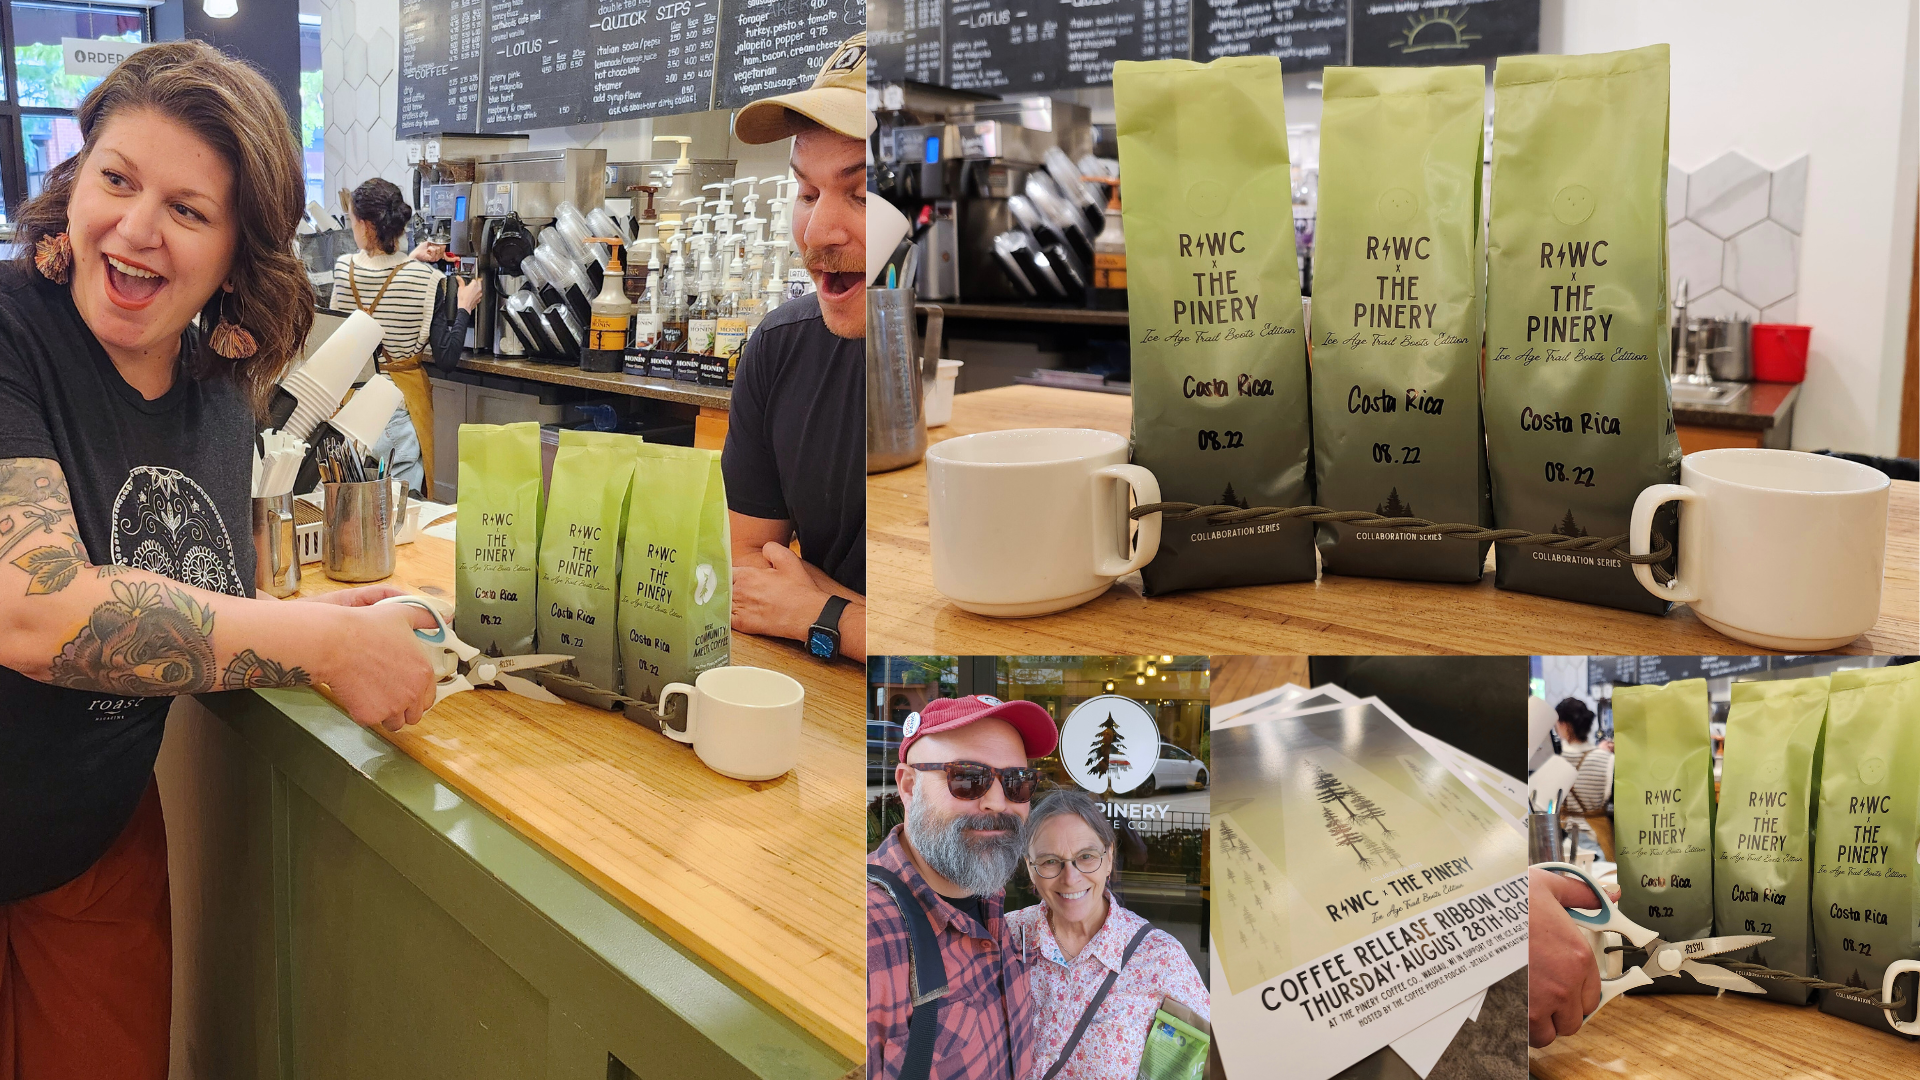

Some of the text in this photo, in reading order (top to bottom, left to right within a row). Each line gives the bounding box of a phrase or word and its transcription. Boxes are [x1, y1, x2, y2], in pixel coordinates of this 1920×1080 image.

[598, 4, 622, 16] double
[601, 1, 691, 31] QUICK SIPS
[738, 12, 770, 27] forager
[969, 9, 1011, 29] LOTUS
[773, 20, 796, 37] pesto
[807, 9, 837, 25] tomato
[506, 39, 543, 58] LOTUS
[597, 45, 620, 56] italian
[734, 38, 772, 55] jalapeño
[775, 31, 805, 49] popper
[790, 44, 816, 57] cream
[816, 39, 842, 53] cheese
[414, 64, 449, 80] COFFEE
[594, 66, 640, 80] hot chocolate
[734, 65, 777, 84] vegetarian
[594, 81, 622, 93] steamer
[740, 82, 762, 96] vegan
[593, 90, 642, 105] add syrup flavor
[608, 107, 621, 115] ask
[1192, 270, 1239, 297] THE
[1376, 276, 1419, 301] THE
[1550, 284, 1596, 312] THE
[1173, 294, 1259, 325] PINERY
[1353, 302, 1437, 329] PINERY
[1140, 322, 1297, 347] Ice Age Trail Boots Edition
[1526, 313, 1613, 343] PINERY
[1321, 331, 1470, 350] Ice Age Trail Boots Edition
[625, 354, 646, 363] MONIN
[650, 357, 673, 366] MONIN
[676, 360, 699, 368] MONIN
[1492, 346, 1649, 366] Ice Age Trail Boots Edition
[701, 363, 725, 373] MONIN
[1183, 373, 1275, 399] Costa Rica
[1347, 384, 1445, 415] Costa Rica
[1520, 406, 1621, 435] Costa Rica
[1198, 429, 1245, 451] 08.22
[1372, 442, 1421, 465] 08.22
[1545, 461, 1596, 488] 08.22
[487, 534, 507, 548] THE
[1190, 522, 1281, 542] COLLABORATION SERIES
[1356, 532, 1417, 541] COLLABORATION
[475, 548, 516, 562] PINERY
[572, 546, 594, 563] THE
[1532, 551, 1622, 568] COLLABORATION SERIES
[558, 559, 599, 579] PINERY
[650, 567, 669, 586] THE
[475, 587, 518, 602] Costa Rica
[636, 581, 673, 605] PINERY
[480, 613, 502, 625] 08.22
[550, 602, 596, 626] Costa Rica
[561, 633, 583, 648] 08.22
[629, 628, 671, 654] Costa Rica
[638, 659, 660, 677] 08.22
[88, 697, 145, 711] roast
[1652, 812, 1676, 829] THE
[1753, 817, 1779, 834] THE
[1639, 827, 1686, 846] PINERY
[1737, 833, 1787, 852] PINERY
[1853, 825, 1881, 844] THE
[1837, 844, 1889, 865] PINERY
[1387, 873, 1423, 897] THE
[1421, 856, 1474, 885] PINERY
[1641, 873, 1692, 888] Costa Rica
[1731, 883, 1787, 906] Costa Rica
[1386, 904, 1403, 918] Age
[1403, 897, 1421, 911] Trail
[1648, 905, 1674, 918] 08.22
[1830, 902, 1888, 926] Costa Rica
[1744, 919, 1772, 934] 08.22
[1261, 876, 1529, 1011] COFFEE RELEASE RIBBON CUTT
[1685, 941, 1705, 954] TASTY
[1843, 937, 1872, 957] 08.22
[1328, 925, 1525, 1029] AT THE PINERY COFFEE WAUSAU, IN SUPPORT OF THE AGE
[1358, 949, 1496, 1027] HOSTED BY THE COFFEE PEOPLE PODCAST DETAILS AT
